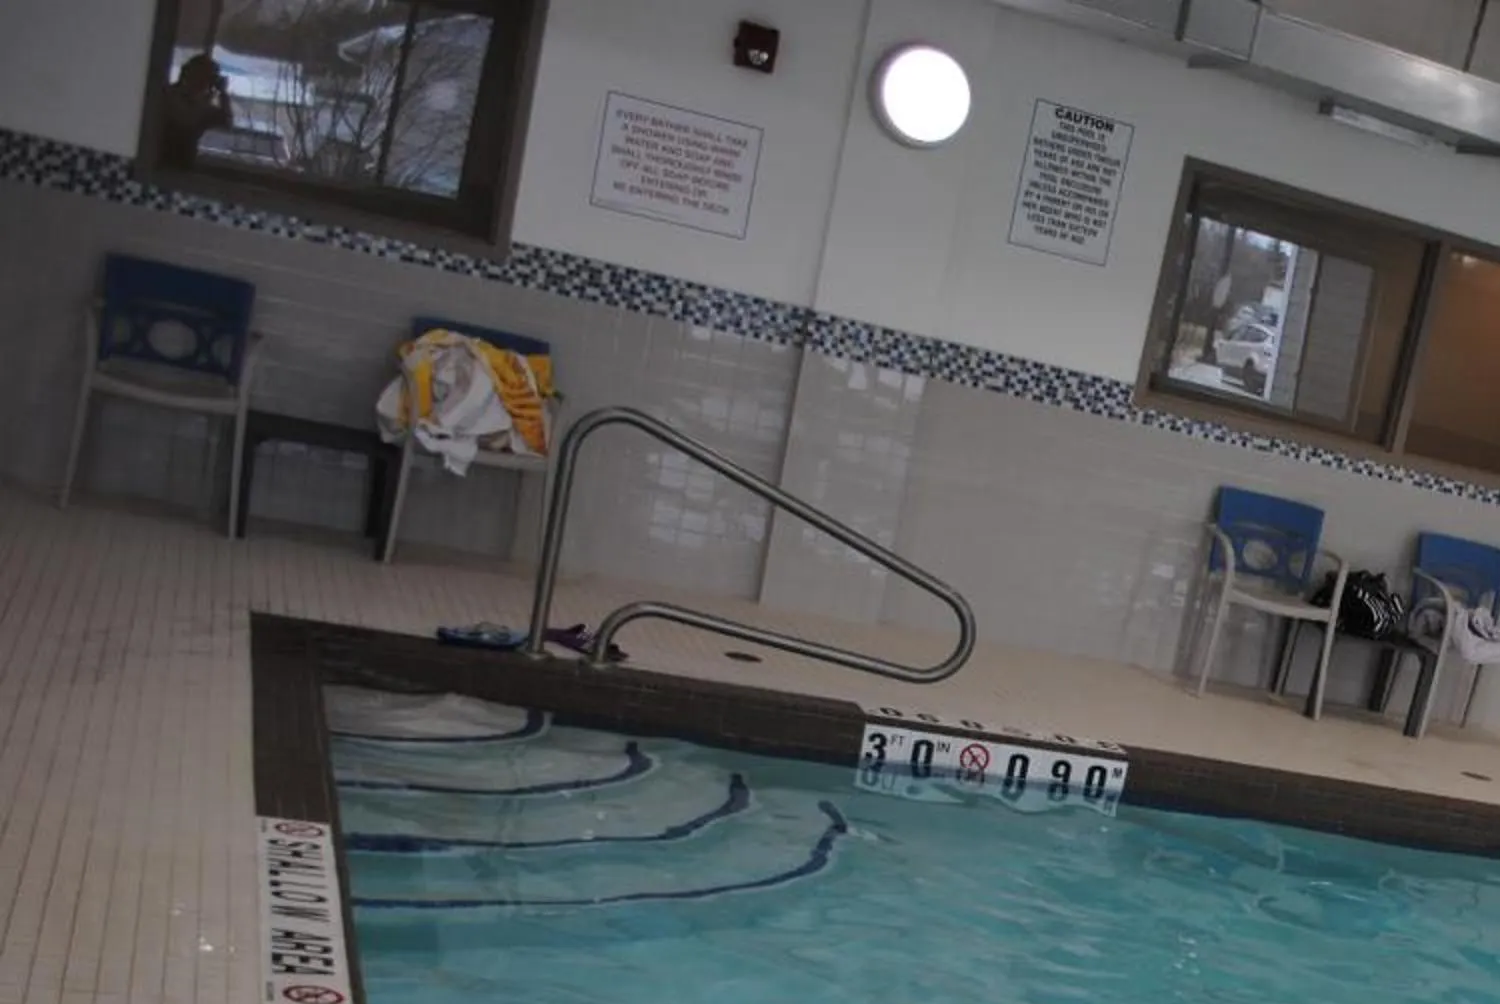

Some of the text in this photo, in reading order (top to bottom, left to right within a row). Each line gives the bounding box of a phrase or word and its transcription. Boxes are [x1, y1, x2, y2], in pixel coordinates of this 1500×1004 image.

[1054, 107, 1114, 133] CAUTION
[267, 838, 336, 976] SHALLOW AREA
